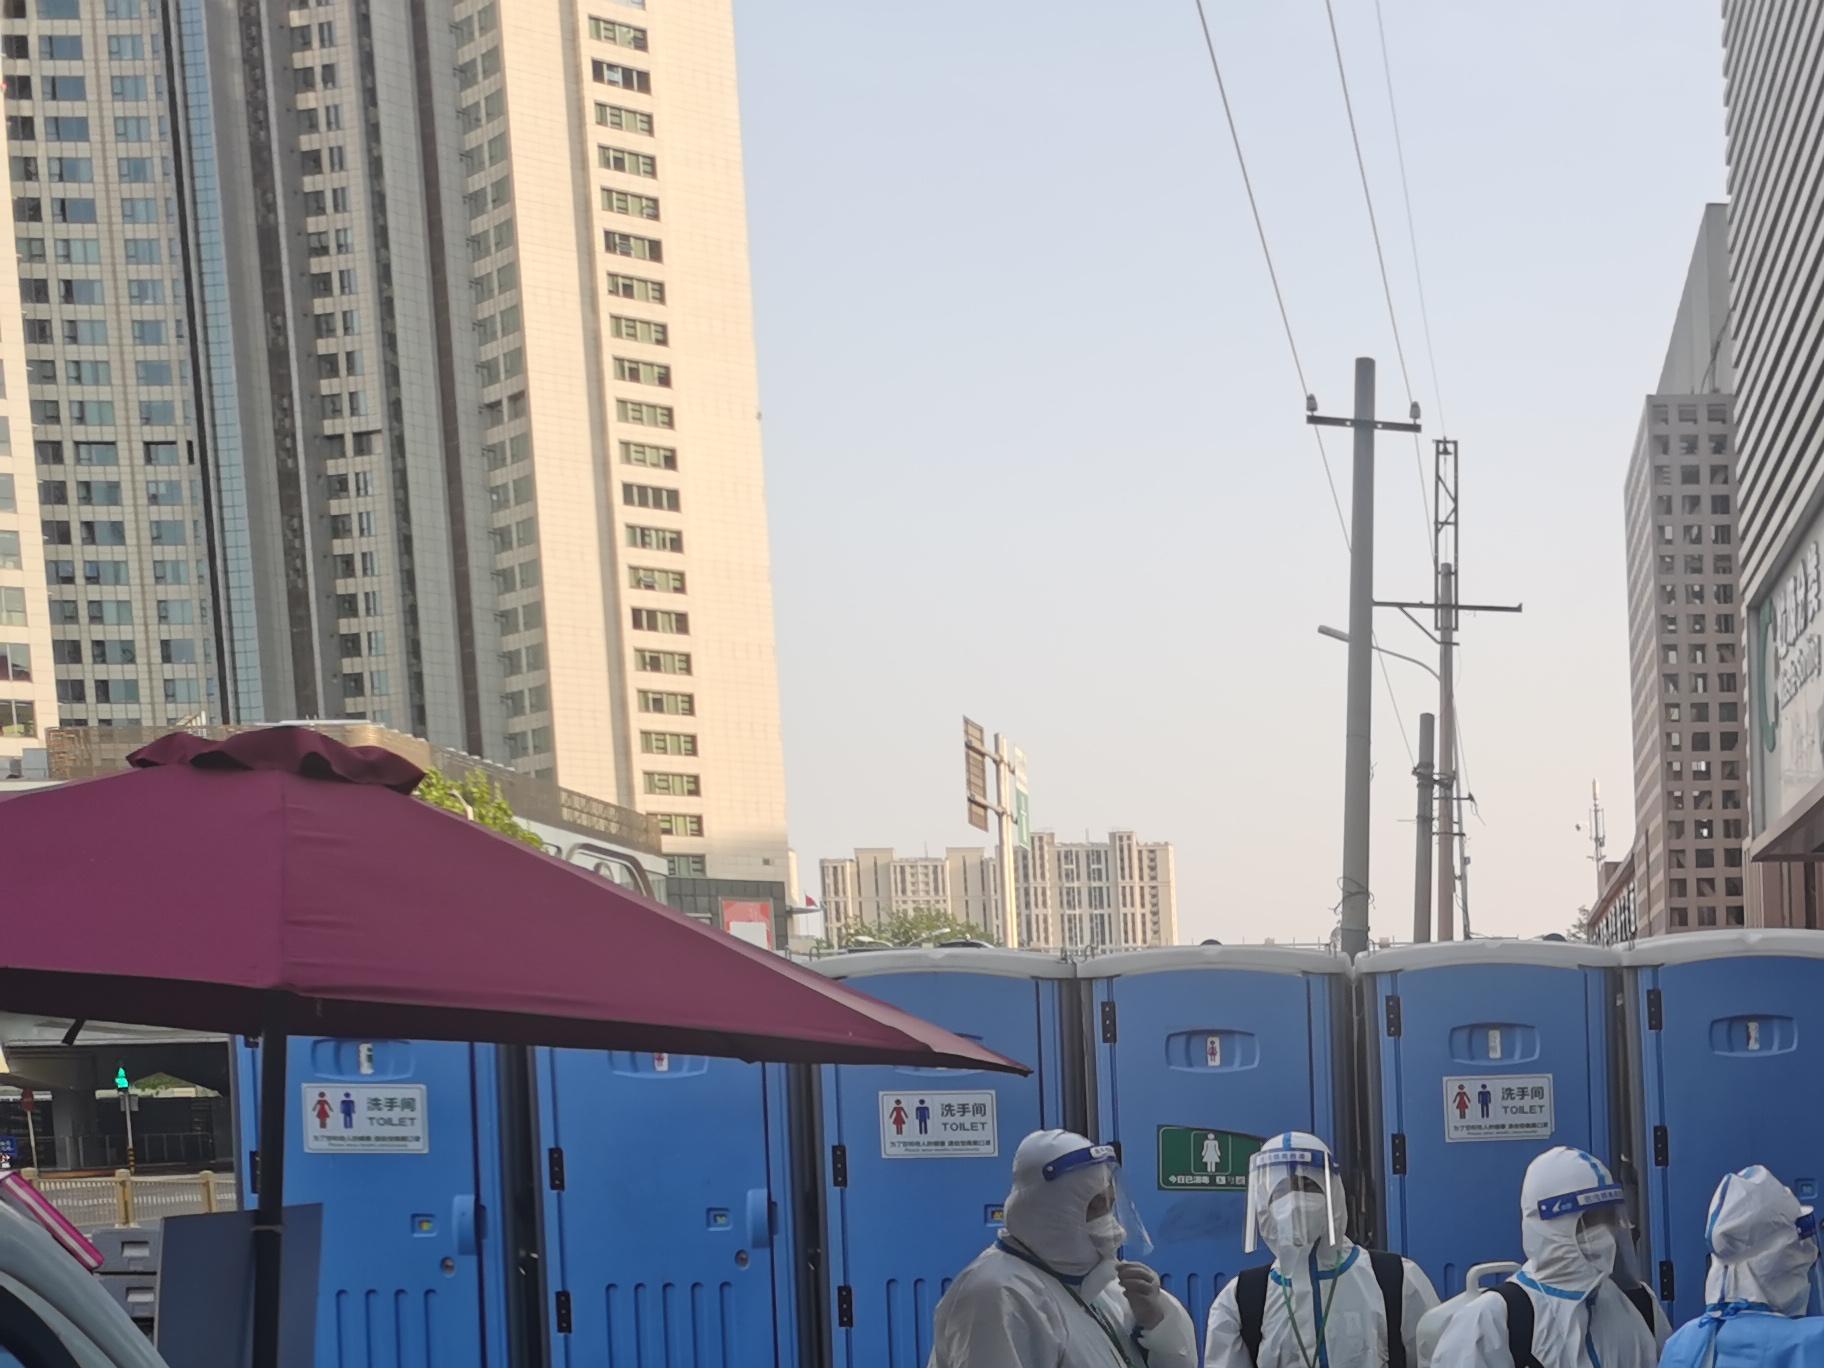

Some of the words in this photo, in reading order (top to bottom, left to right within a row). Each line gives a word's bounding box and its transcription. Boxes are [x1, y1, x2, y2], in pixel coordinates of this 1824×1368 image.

[1501, 1086, 1545, 1101] 洗手间
[367, 1096, 417, 1112] 洗手间
[941, 1103, 987, 1118] 洗手间
[1503, 1105, 1545, 1115] TOILET
[367, 1116, 417, 1127] TOILET
[941, 1121, 988, 1132] TOILET
